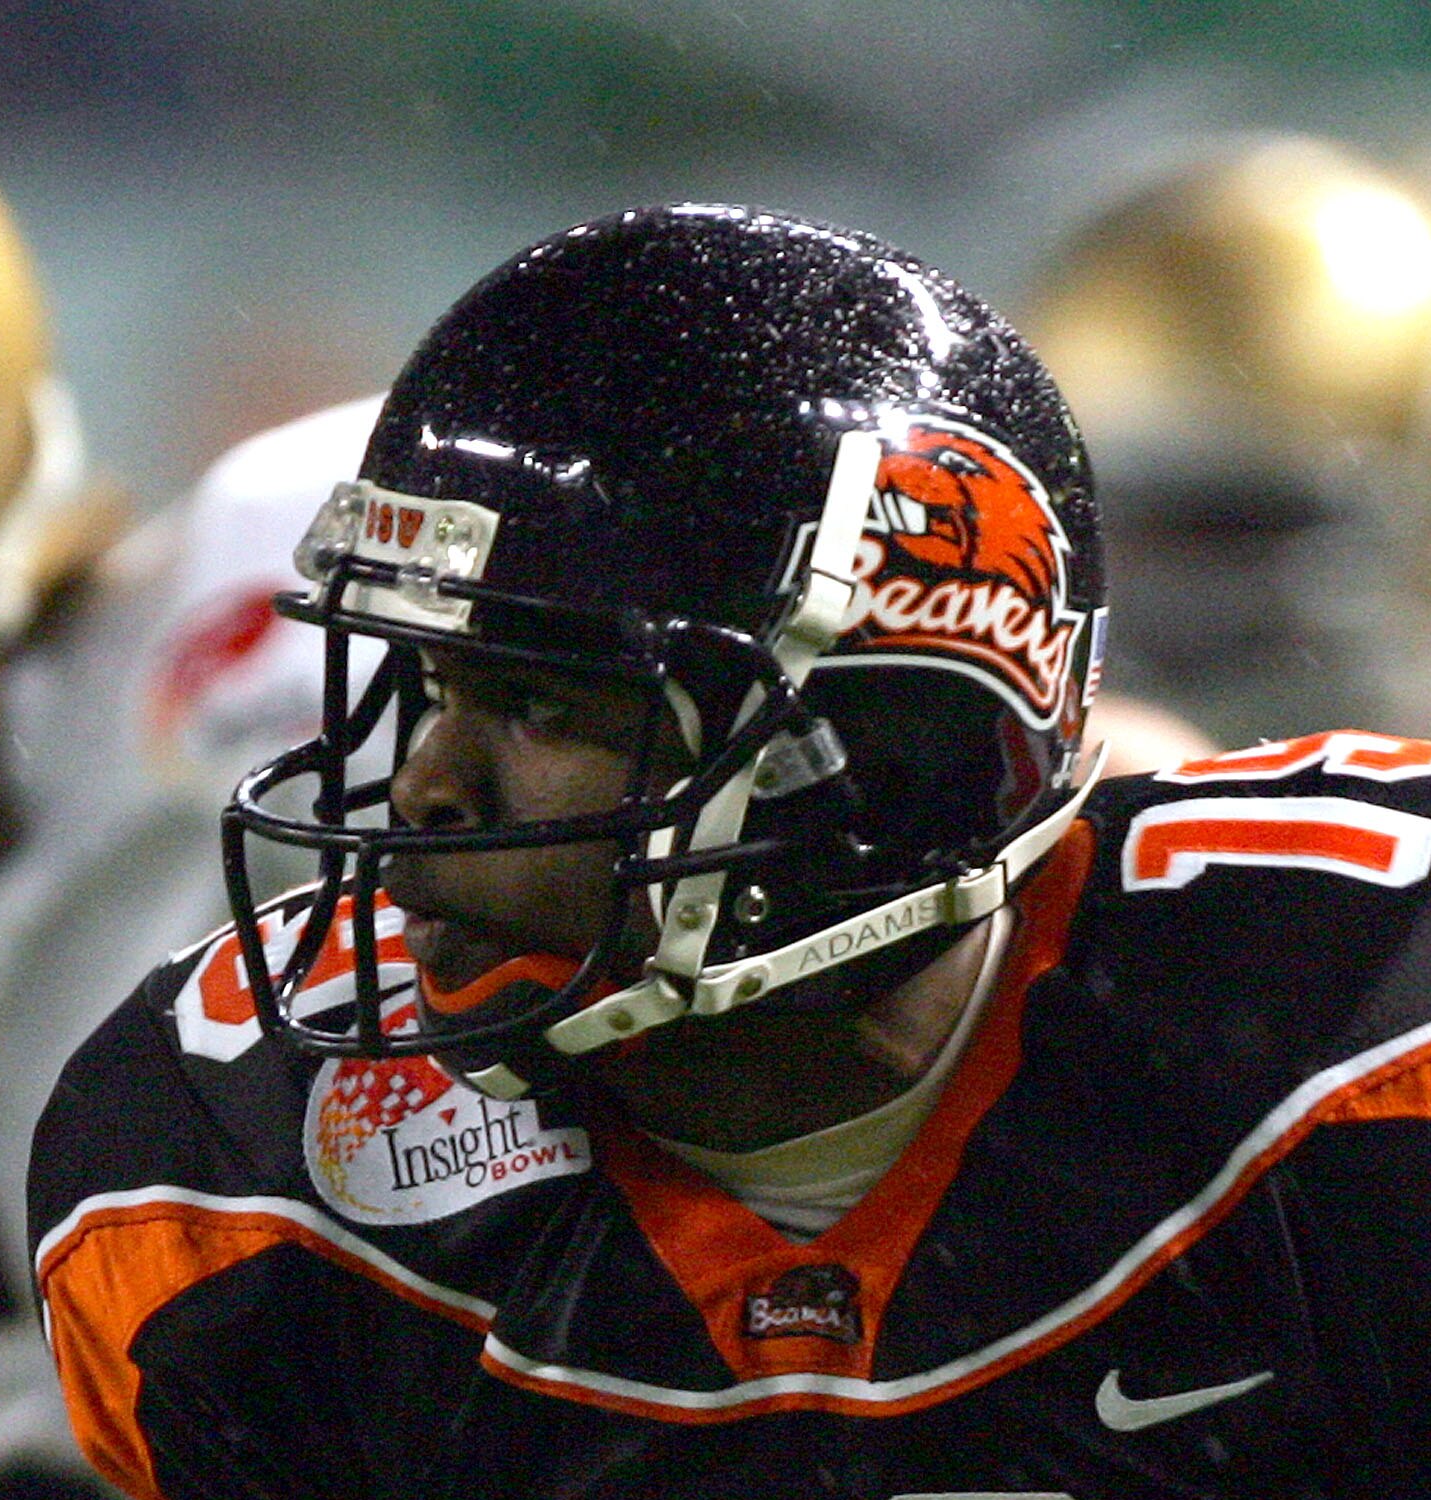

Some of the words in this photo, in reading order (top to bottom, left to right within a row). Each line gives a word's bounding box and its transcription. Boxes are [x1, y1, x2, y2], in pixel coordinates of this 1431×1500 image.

[797, 901, 939, 972] ADAMS
[381, 1097, 528, 1191] Insight
[490, 1142, 582, 1181] BOWL
